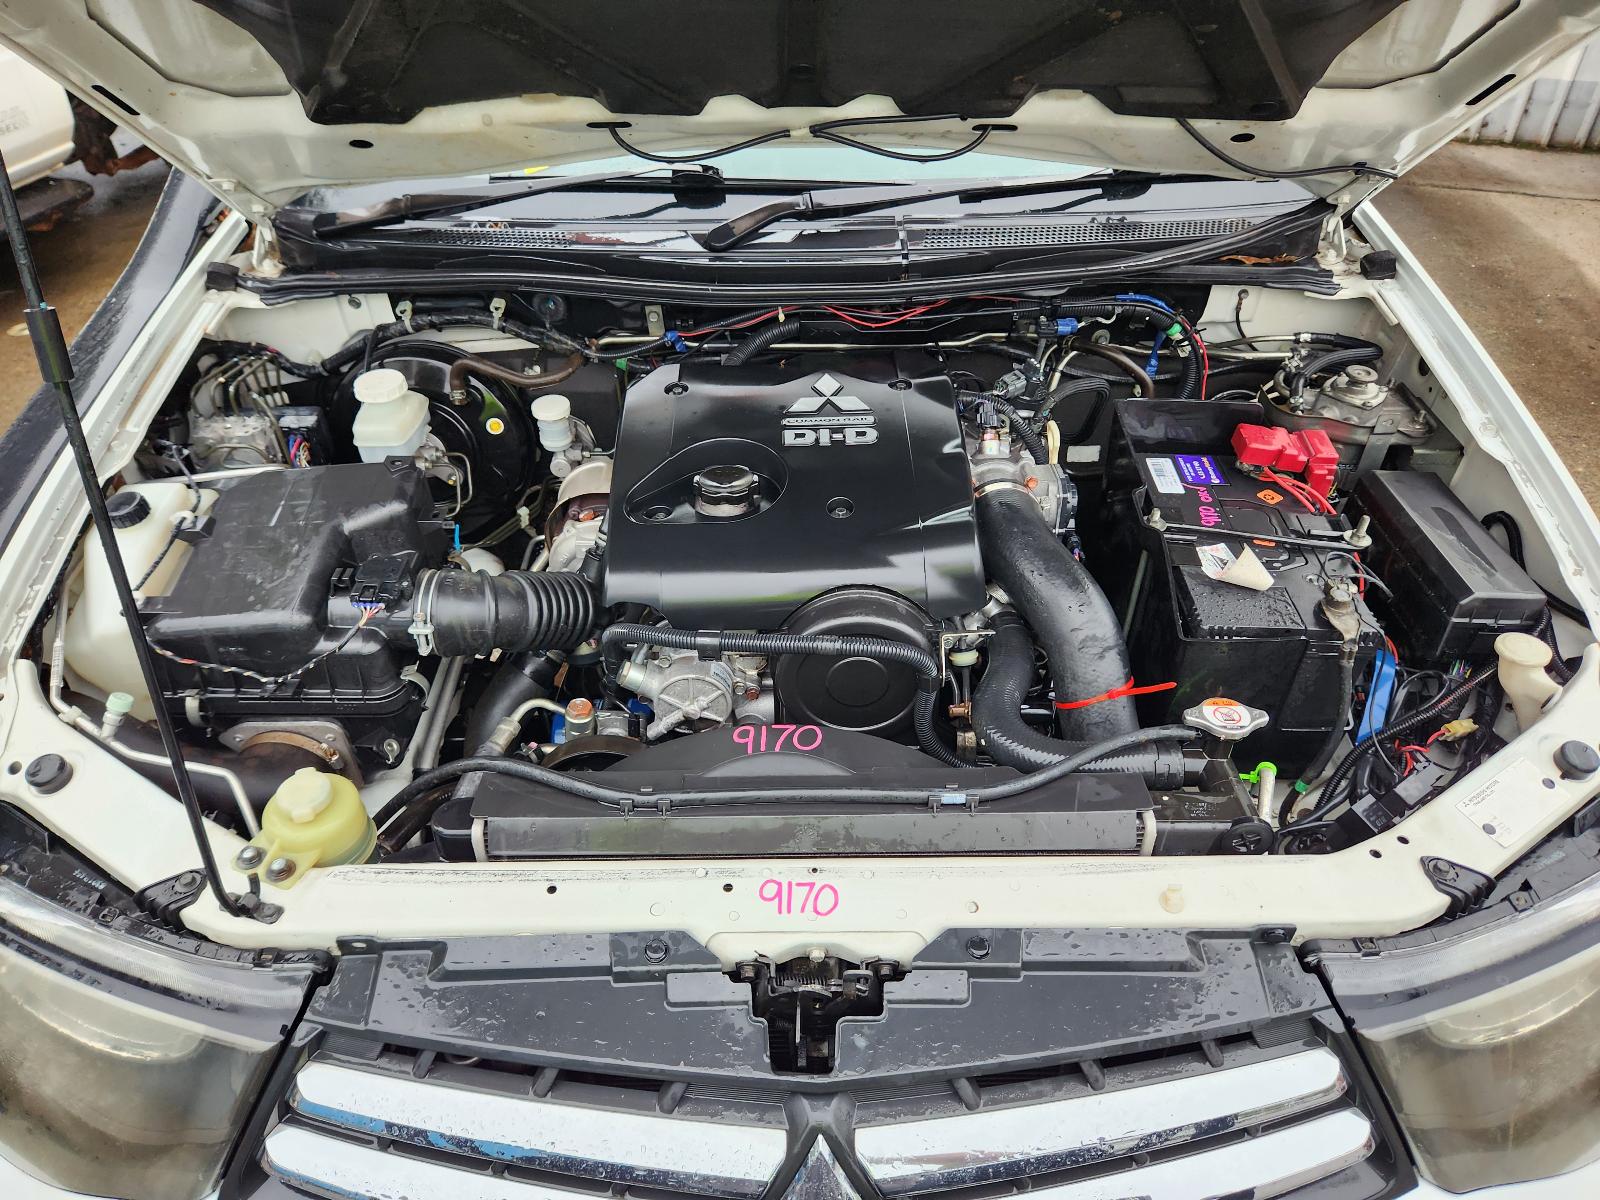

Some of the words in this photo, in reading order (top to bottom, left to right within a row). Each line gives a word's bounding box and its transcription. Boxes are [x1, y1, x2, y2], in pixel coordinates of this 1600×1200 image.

[782, 427, 880, 447] DI-D
[733, 724, 823, 755] 9170
[758, 879, 840, 917] 9170
